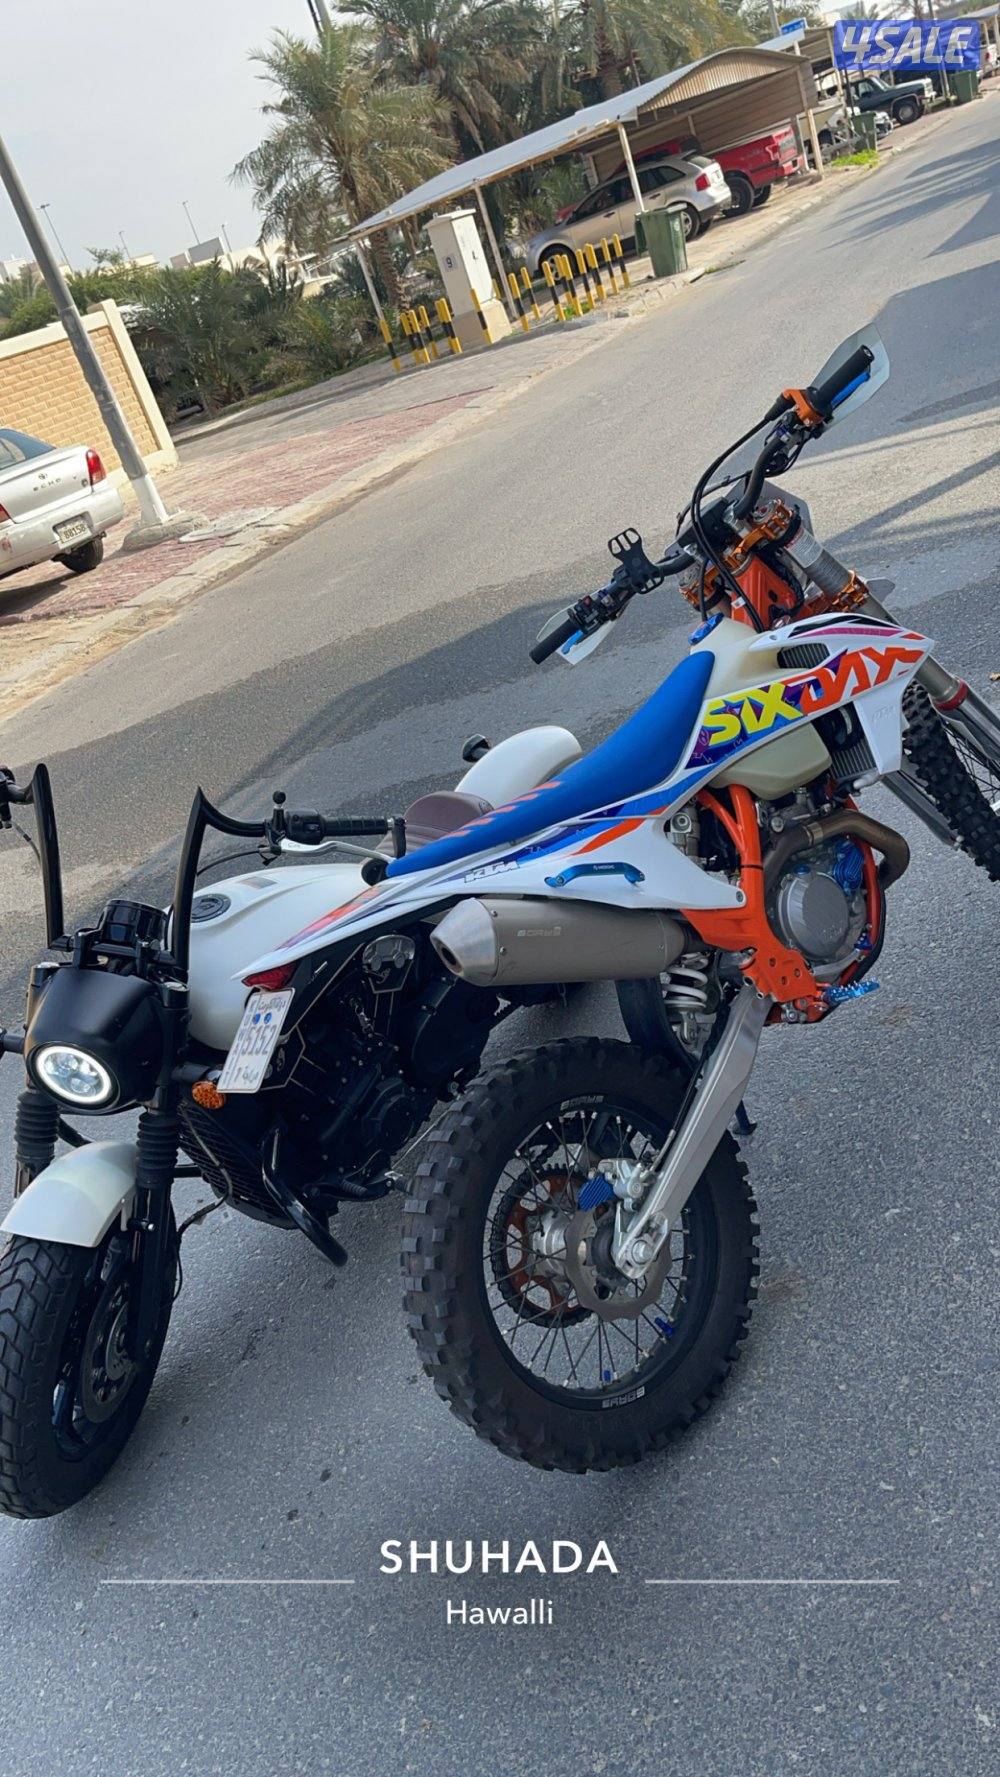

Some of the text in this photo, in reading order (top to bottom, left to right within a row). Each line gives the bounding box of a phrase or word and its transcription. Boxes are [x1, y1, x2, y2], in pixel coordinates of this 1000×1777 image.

[702, 681, 803, 746] SIX
[464, 861, 520, 884] KTM
[240, 1025, 277, 1056] 5152
